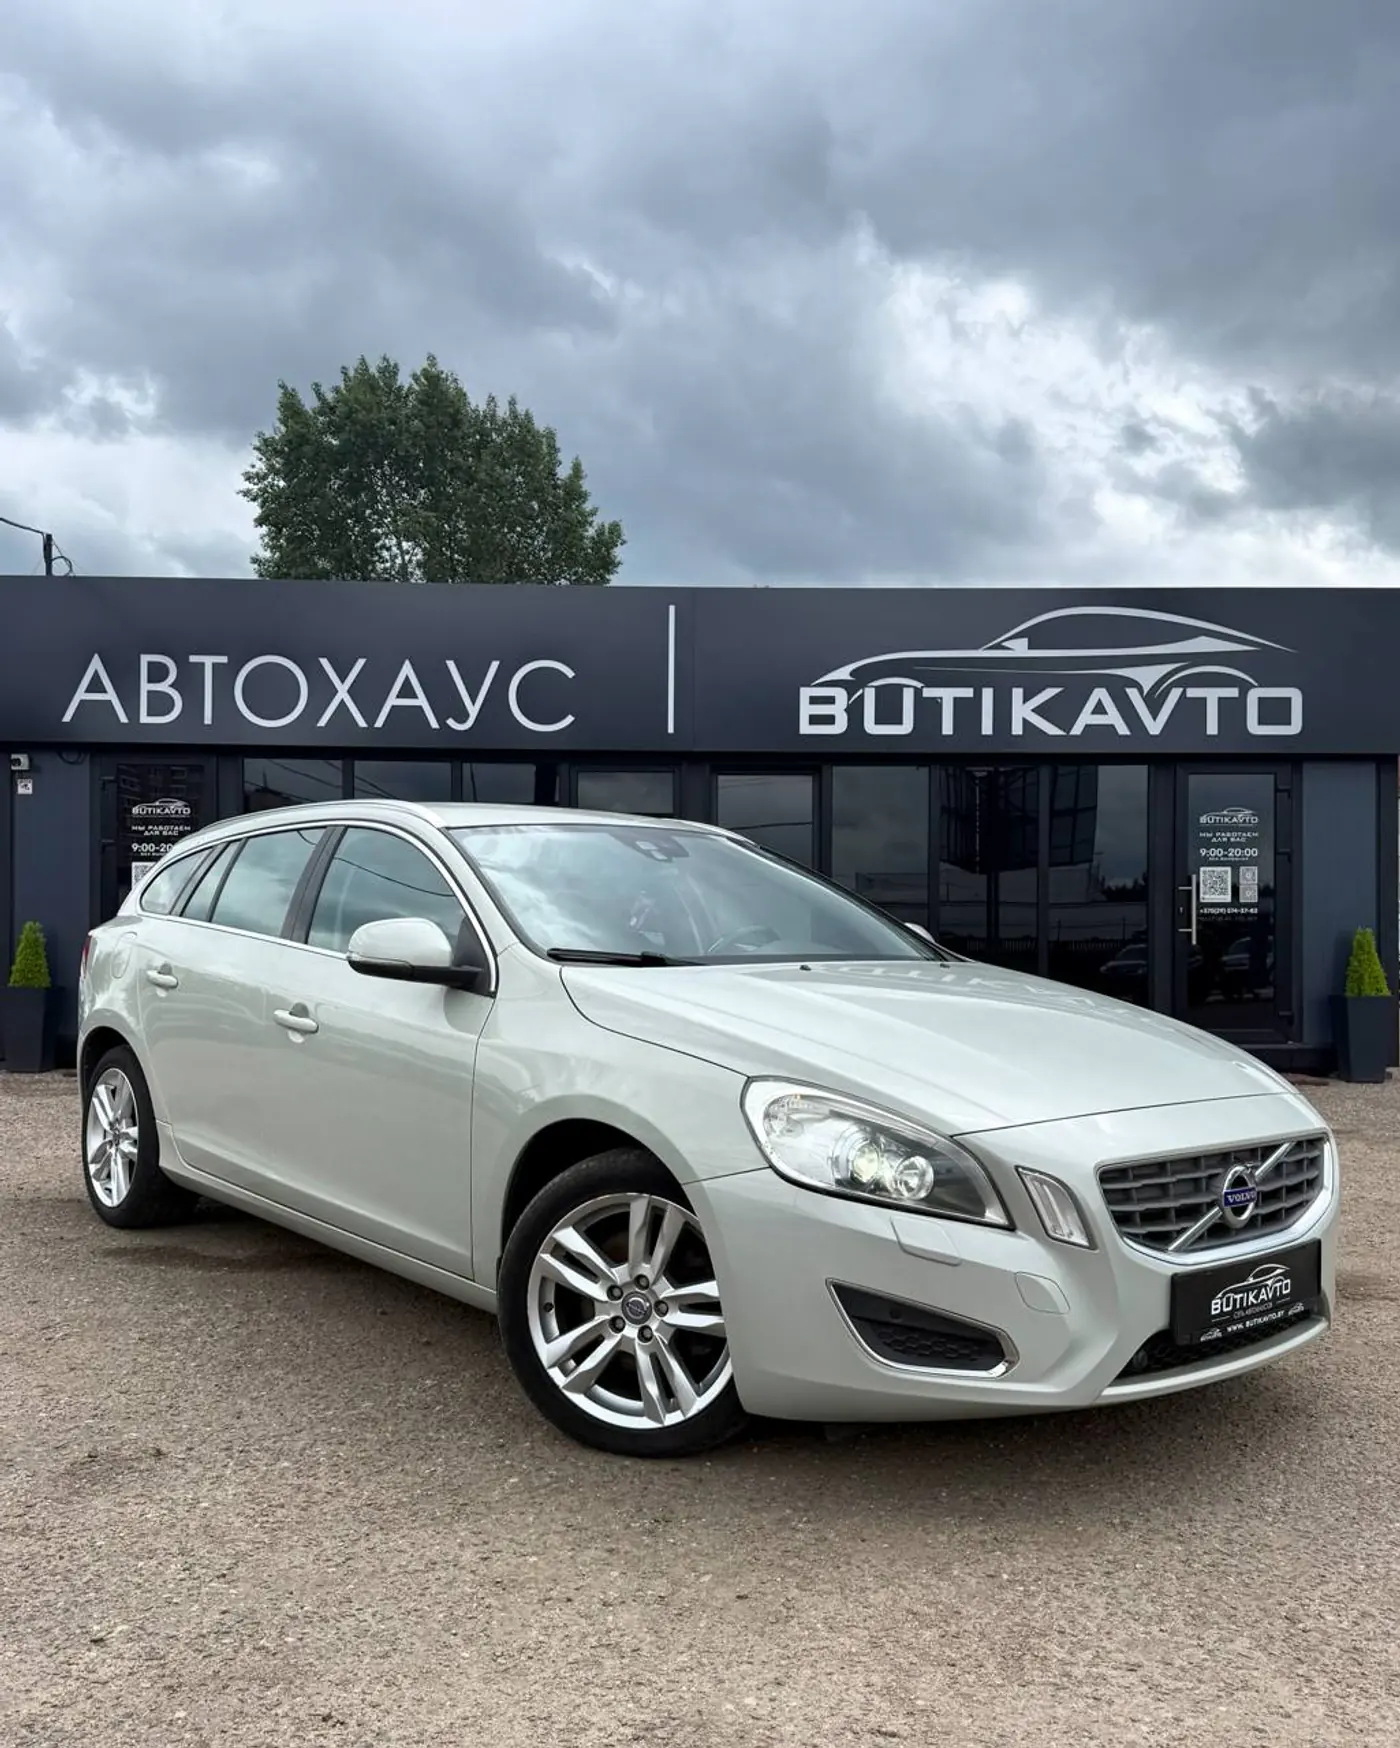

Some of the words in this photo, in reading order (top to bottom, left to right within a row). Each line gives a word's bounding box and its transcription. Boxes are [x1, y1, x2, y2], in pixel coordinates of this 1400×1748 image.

[61, 653, 576, 732] АВТОХАУС
[799, 687, 1303, 736] BUTIKAVTO
[131, 806, 192, 815] BUTIKAVTO
[1199, 815, 1259, 824] BUTIKAVTO
[131, 842, 174, 852] 9:00-20
[1199, 848, 1259, 857] 9:00-20:00
[1226, 1190, 1256, 1203] VOLVO
[1211, 1279, 1291, 1316] BUTIKAVTO
